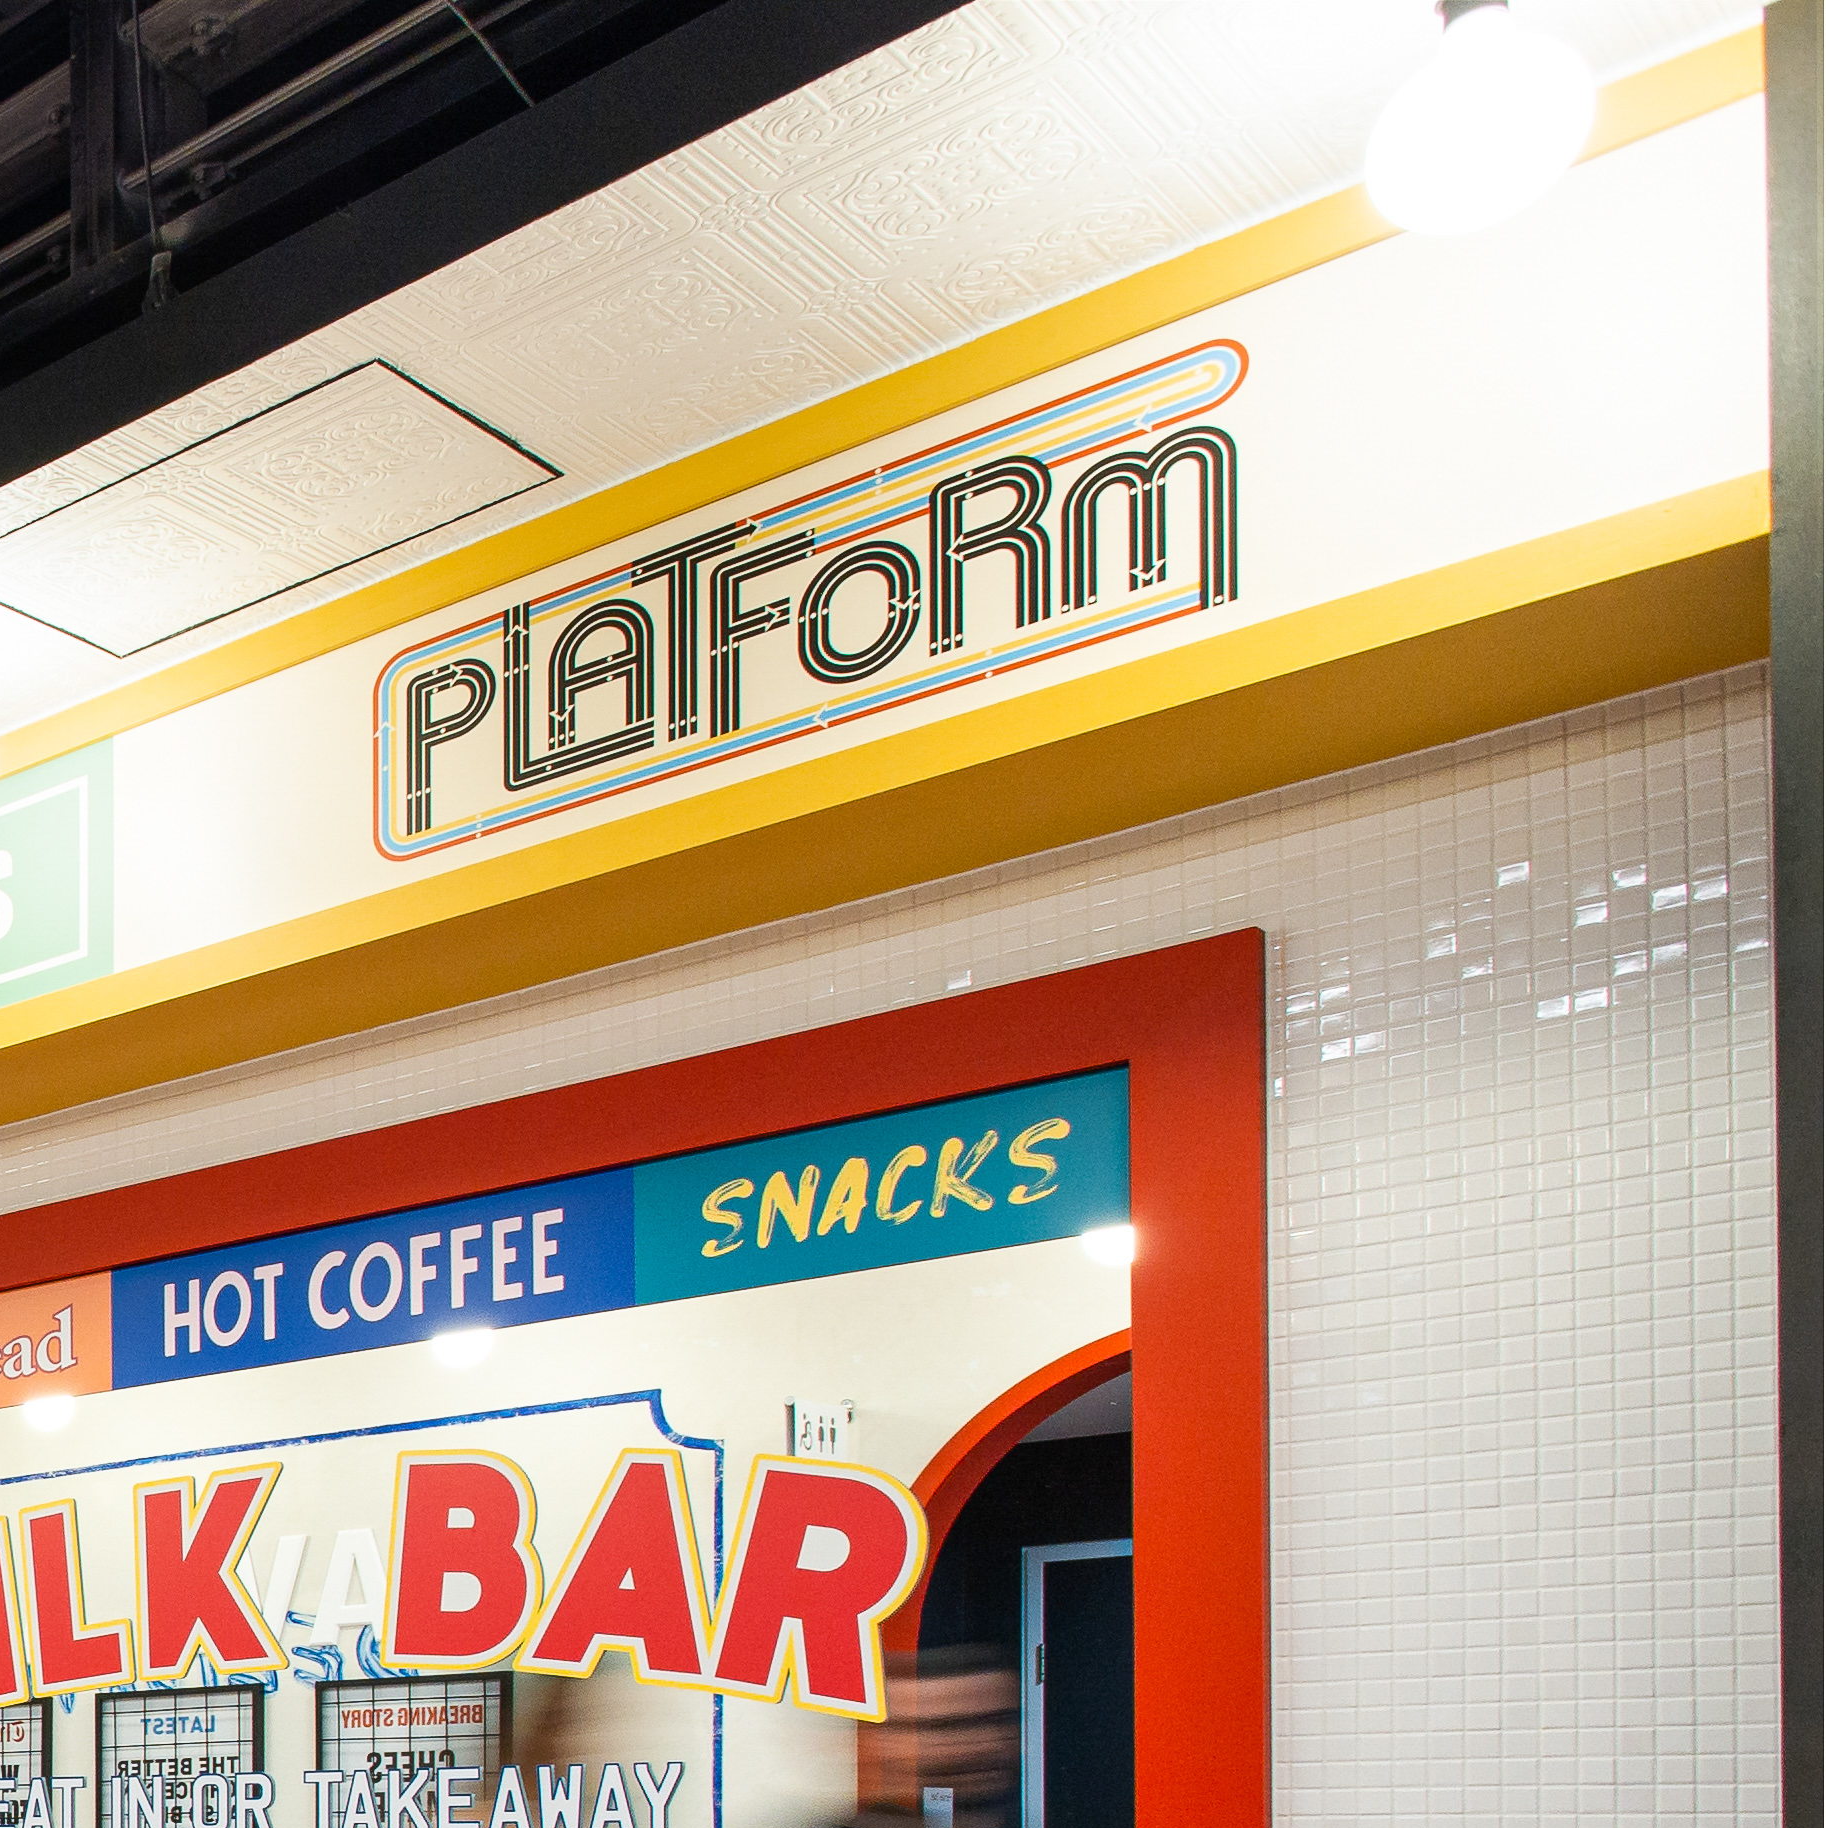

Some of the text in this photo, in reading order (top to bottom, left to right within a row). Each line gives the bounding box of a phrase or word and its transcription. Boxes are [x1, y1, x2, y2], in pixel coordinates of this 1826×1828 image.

[699, 1118, 1071, 1258] SNACKS
[163, 1207, 566, 1357] HOT COFFEE
[380, 1448, 930, 1723] BAR
